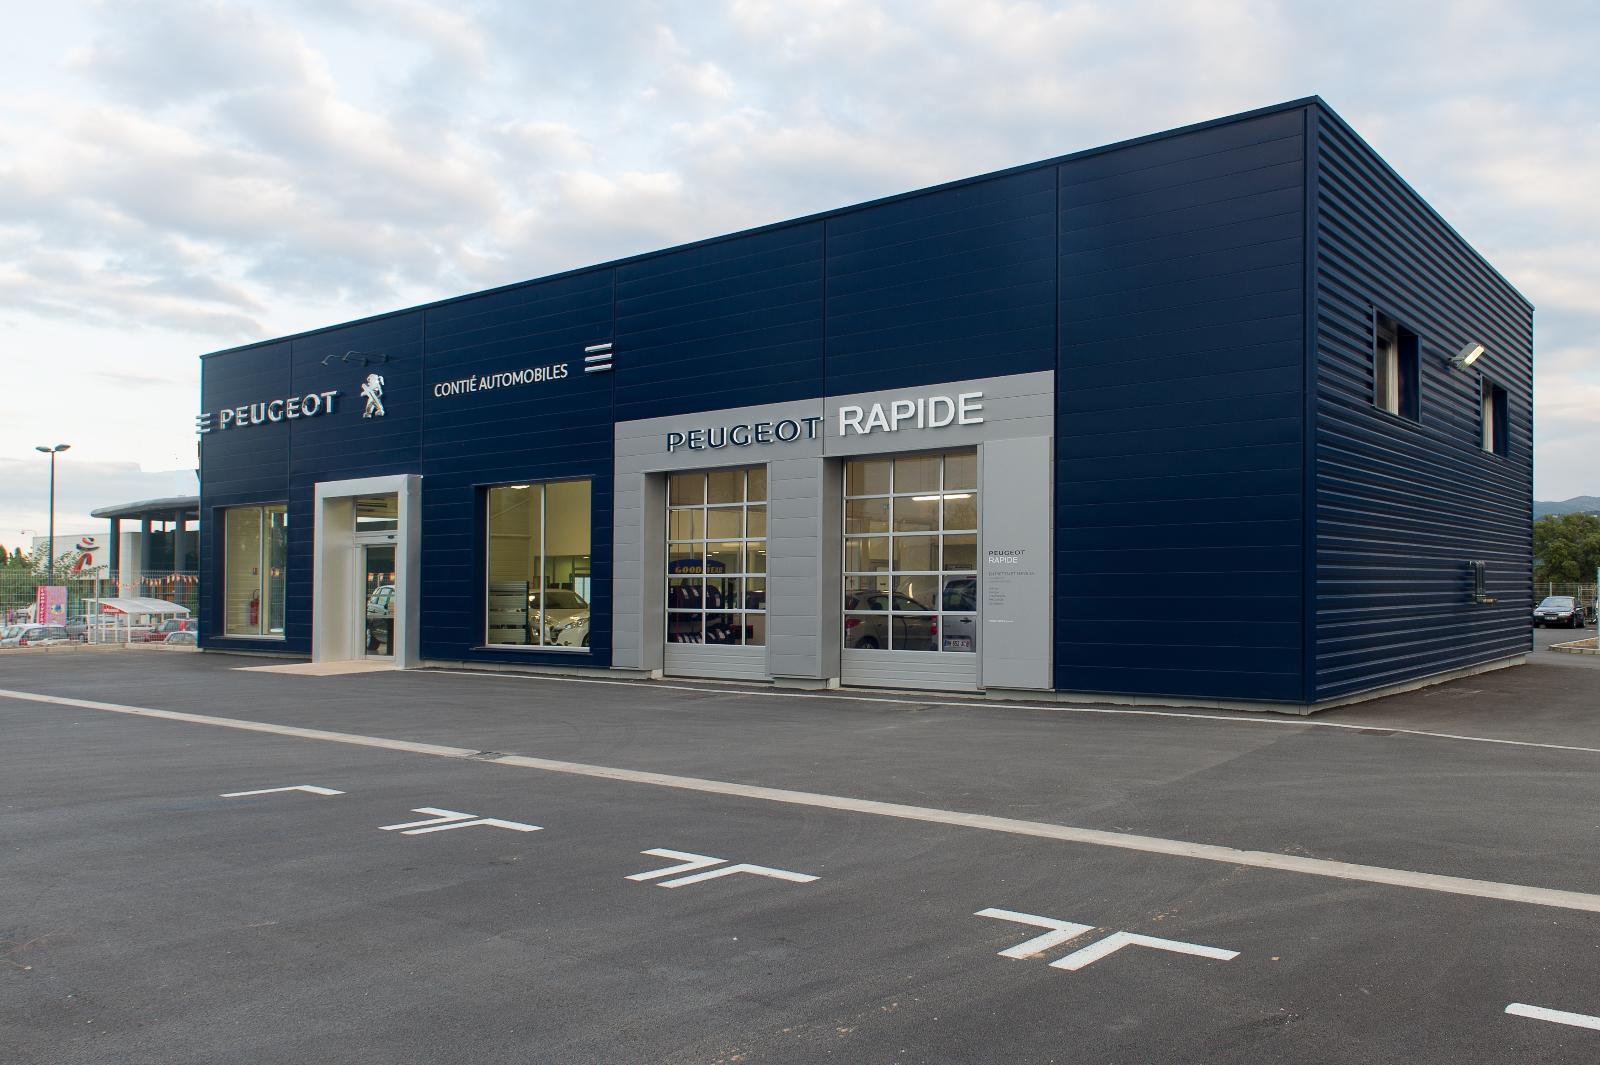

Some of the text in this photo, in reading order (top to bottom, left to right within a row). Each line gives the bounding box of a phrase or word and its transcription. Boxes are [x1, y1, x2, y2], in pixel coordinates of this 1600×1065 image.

[434, 363, 568, 397] CONTIÉ AUTOMOBILES
[220, 390, 338, 430] PEUGEOT
[666, 391, 984, 453] PEUGEOT RAPIDE
[988, 556, 1018, 564] RAPIDE
